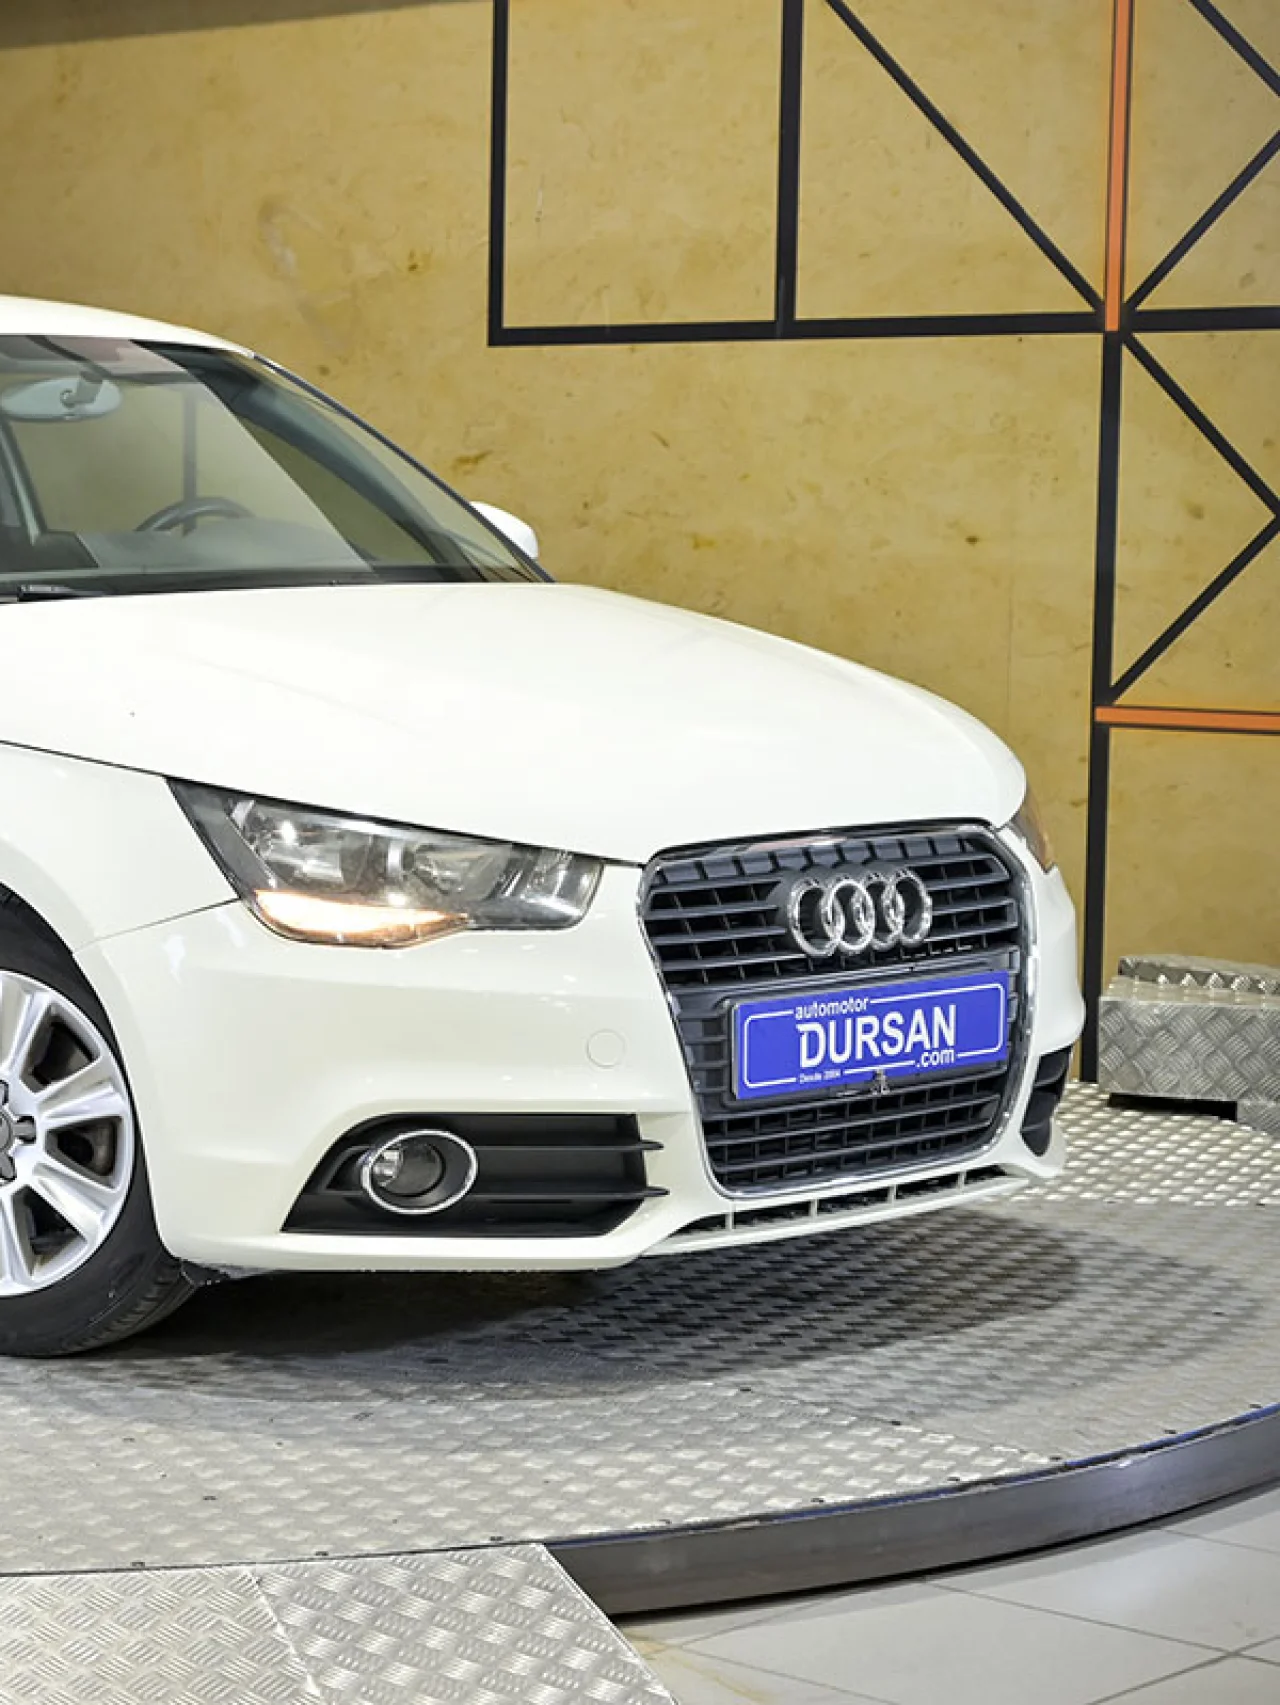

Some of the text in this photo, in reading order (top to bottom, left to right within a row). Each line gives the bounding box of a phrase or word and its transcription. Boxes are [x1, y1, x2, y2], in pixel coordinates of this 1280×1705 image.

[795, 997, 869, 1020] automotor
[796, 1004, 956, 1068] DURSAN
[915, 1049, 955, 1068] .com
